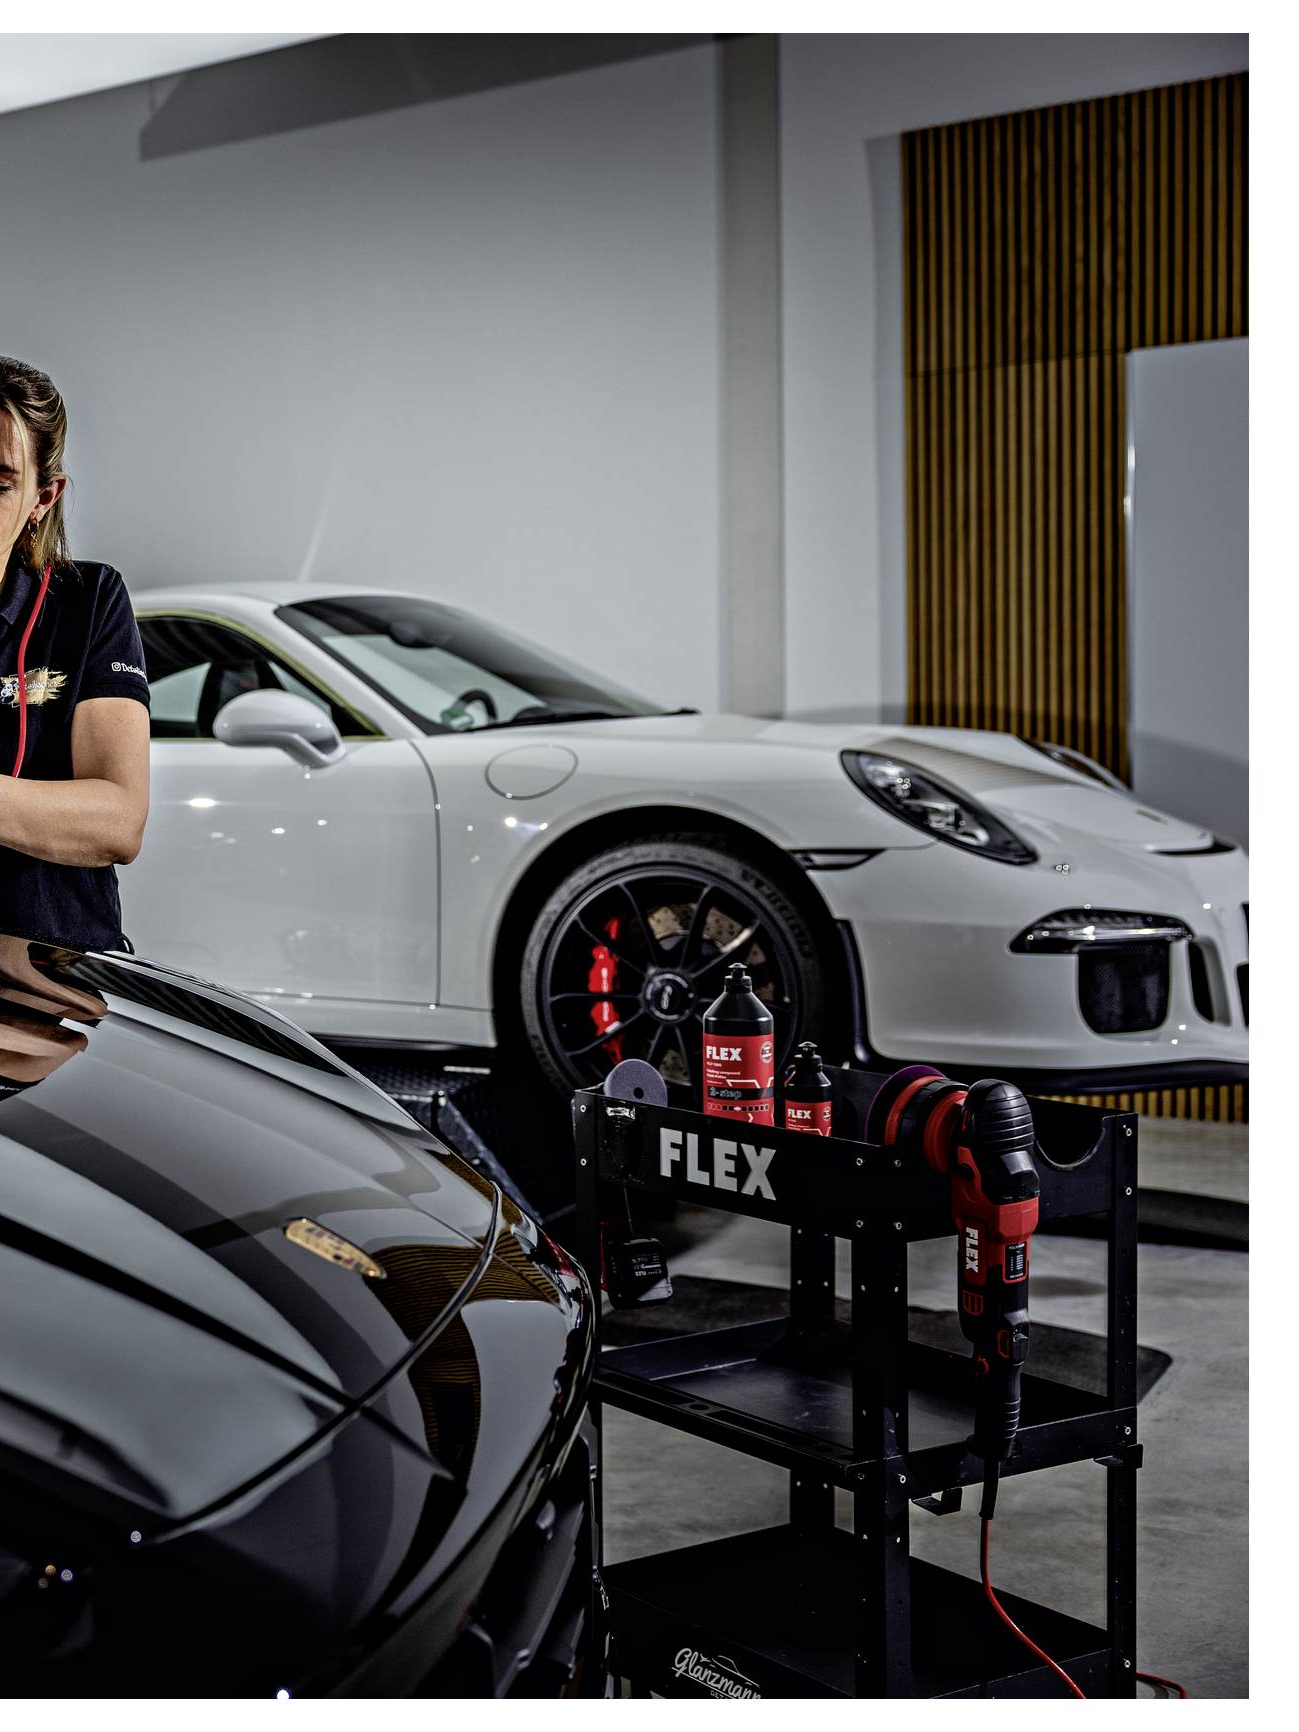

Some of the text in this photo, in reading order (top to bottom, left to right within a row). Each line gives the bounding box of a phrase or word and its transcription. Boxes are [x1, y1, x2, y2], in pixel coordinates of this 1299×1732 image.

[706, 1045, 742, 1061] FLEX
[787, 1108, 812, 1119] FLEX
[660, 1127, 777, 1201] FLEX
[965, 1227, 979, 1273] FLEX
